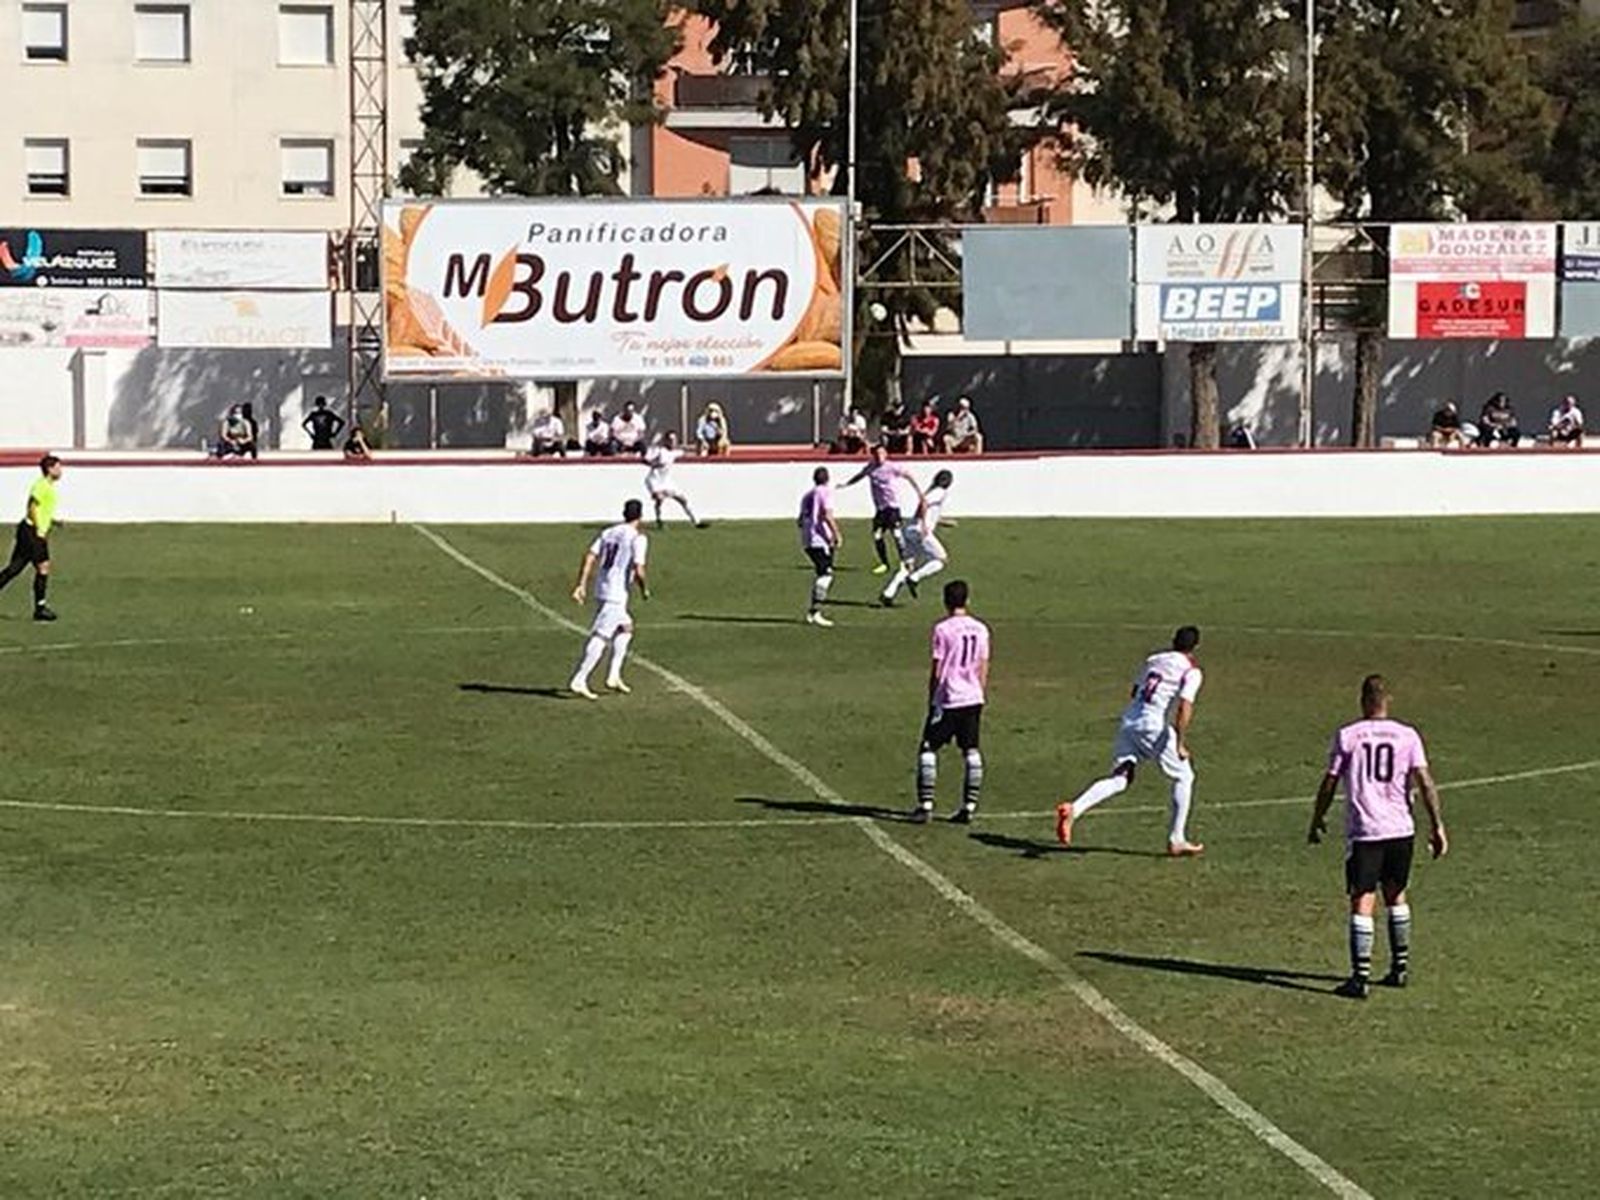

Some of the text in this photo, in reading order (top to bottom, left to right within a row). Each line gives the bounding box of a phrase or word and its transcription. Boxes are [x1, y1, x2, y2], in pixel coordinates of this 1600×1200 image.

[527, 222, 728, 244] Panificadora
[1439, 229, 1547, 240] MADERAS
[1164, 285, 1278, 320] BEEP
[1419, 299, 1525, 313] GADESUR
[960, 634, 976, 668] 11
[1361, 742, 1395, 784] 10
